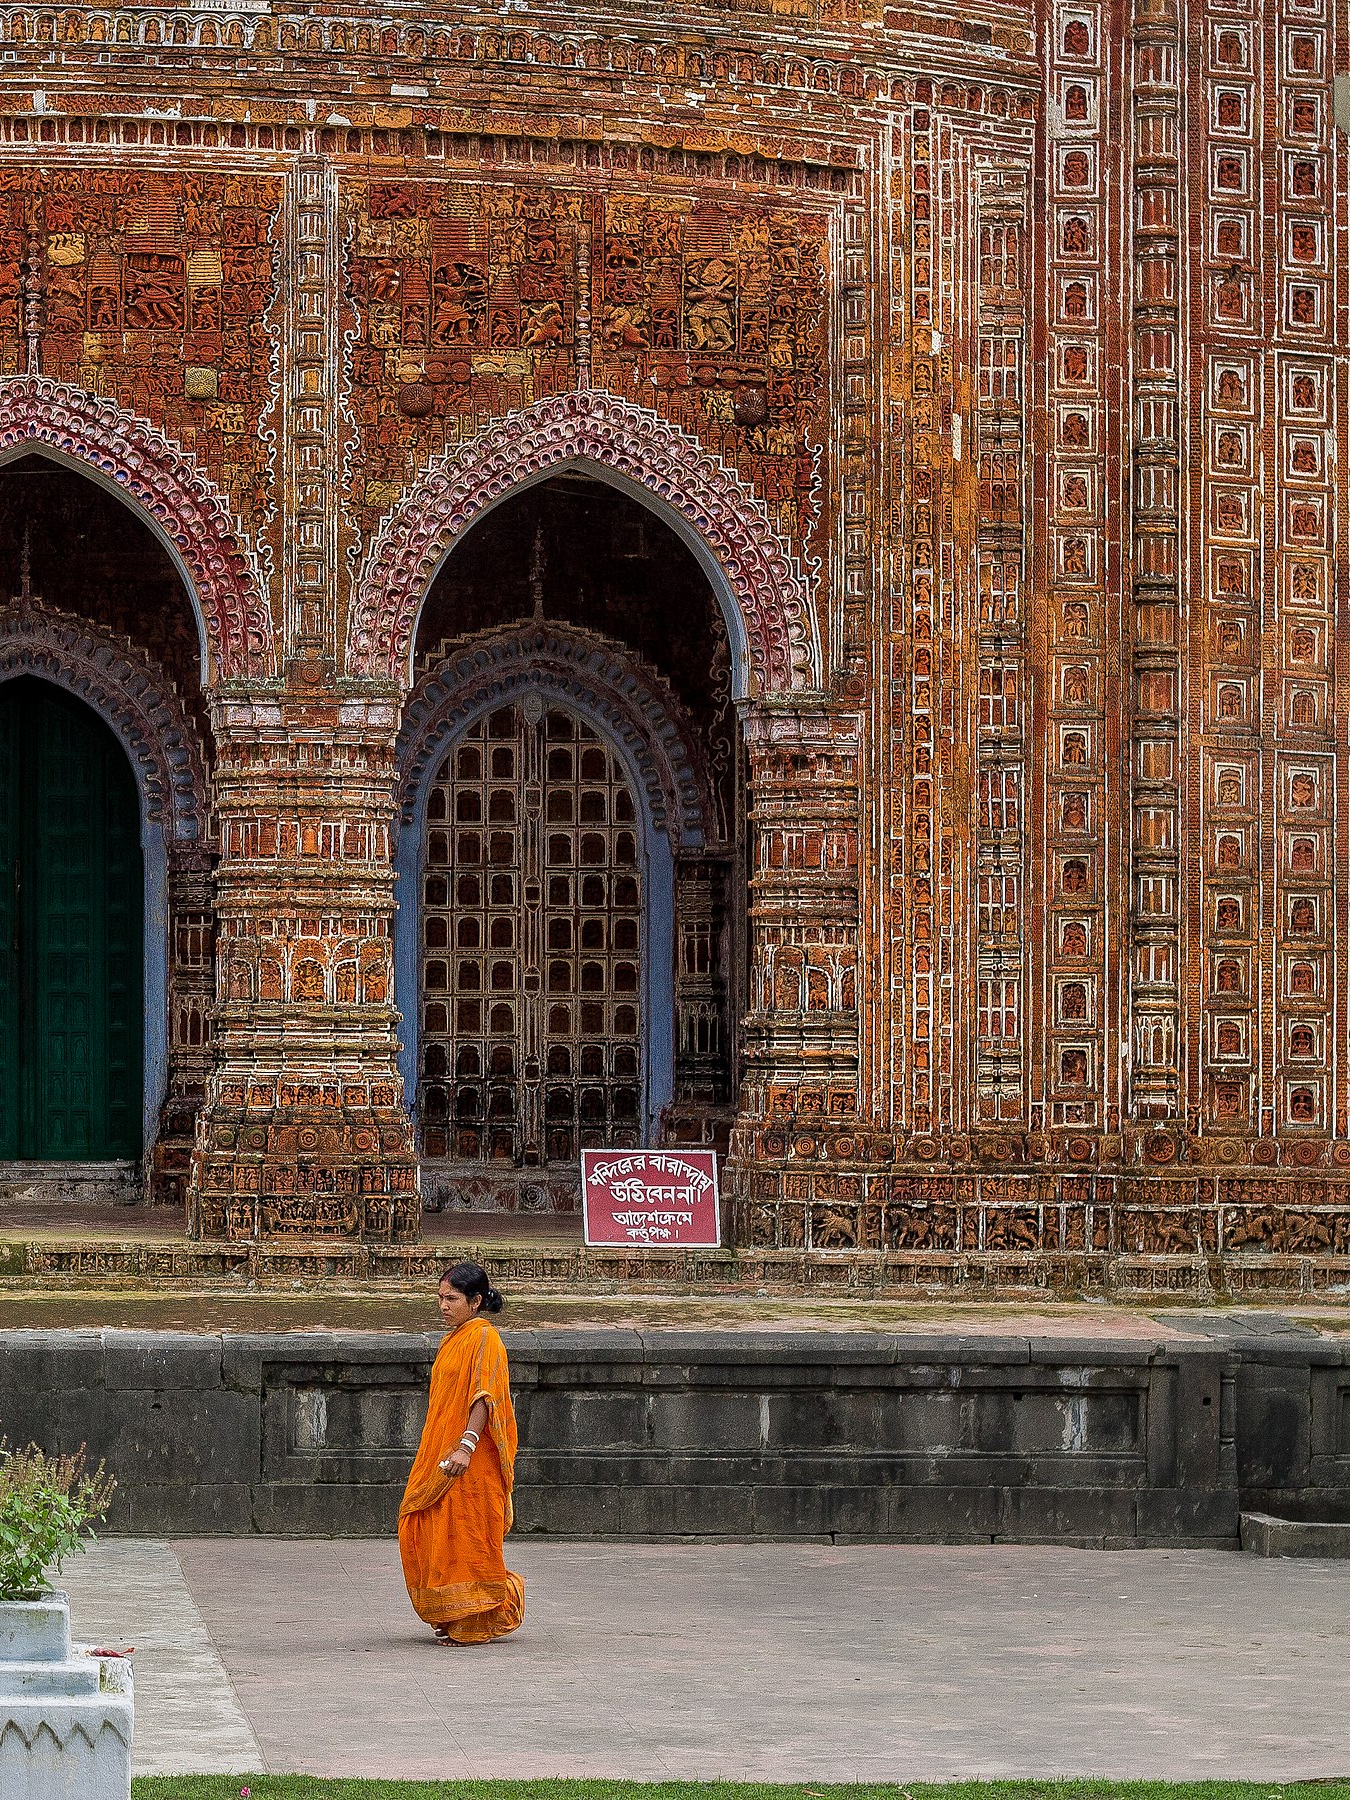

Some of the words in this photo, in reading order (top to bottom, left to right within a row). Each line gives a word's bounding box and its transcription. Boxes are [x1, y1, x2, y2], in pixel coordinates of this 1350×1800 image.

[587, 1155, 646, 1186] মন্দিরের
[648, 1154, 714, 1192] বারান্দায়
[612, 1210, 693, 1227] আদেশক্রমে
